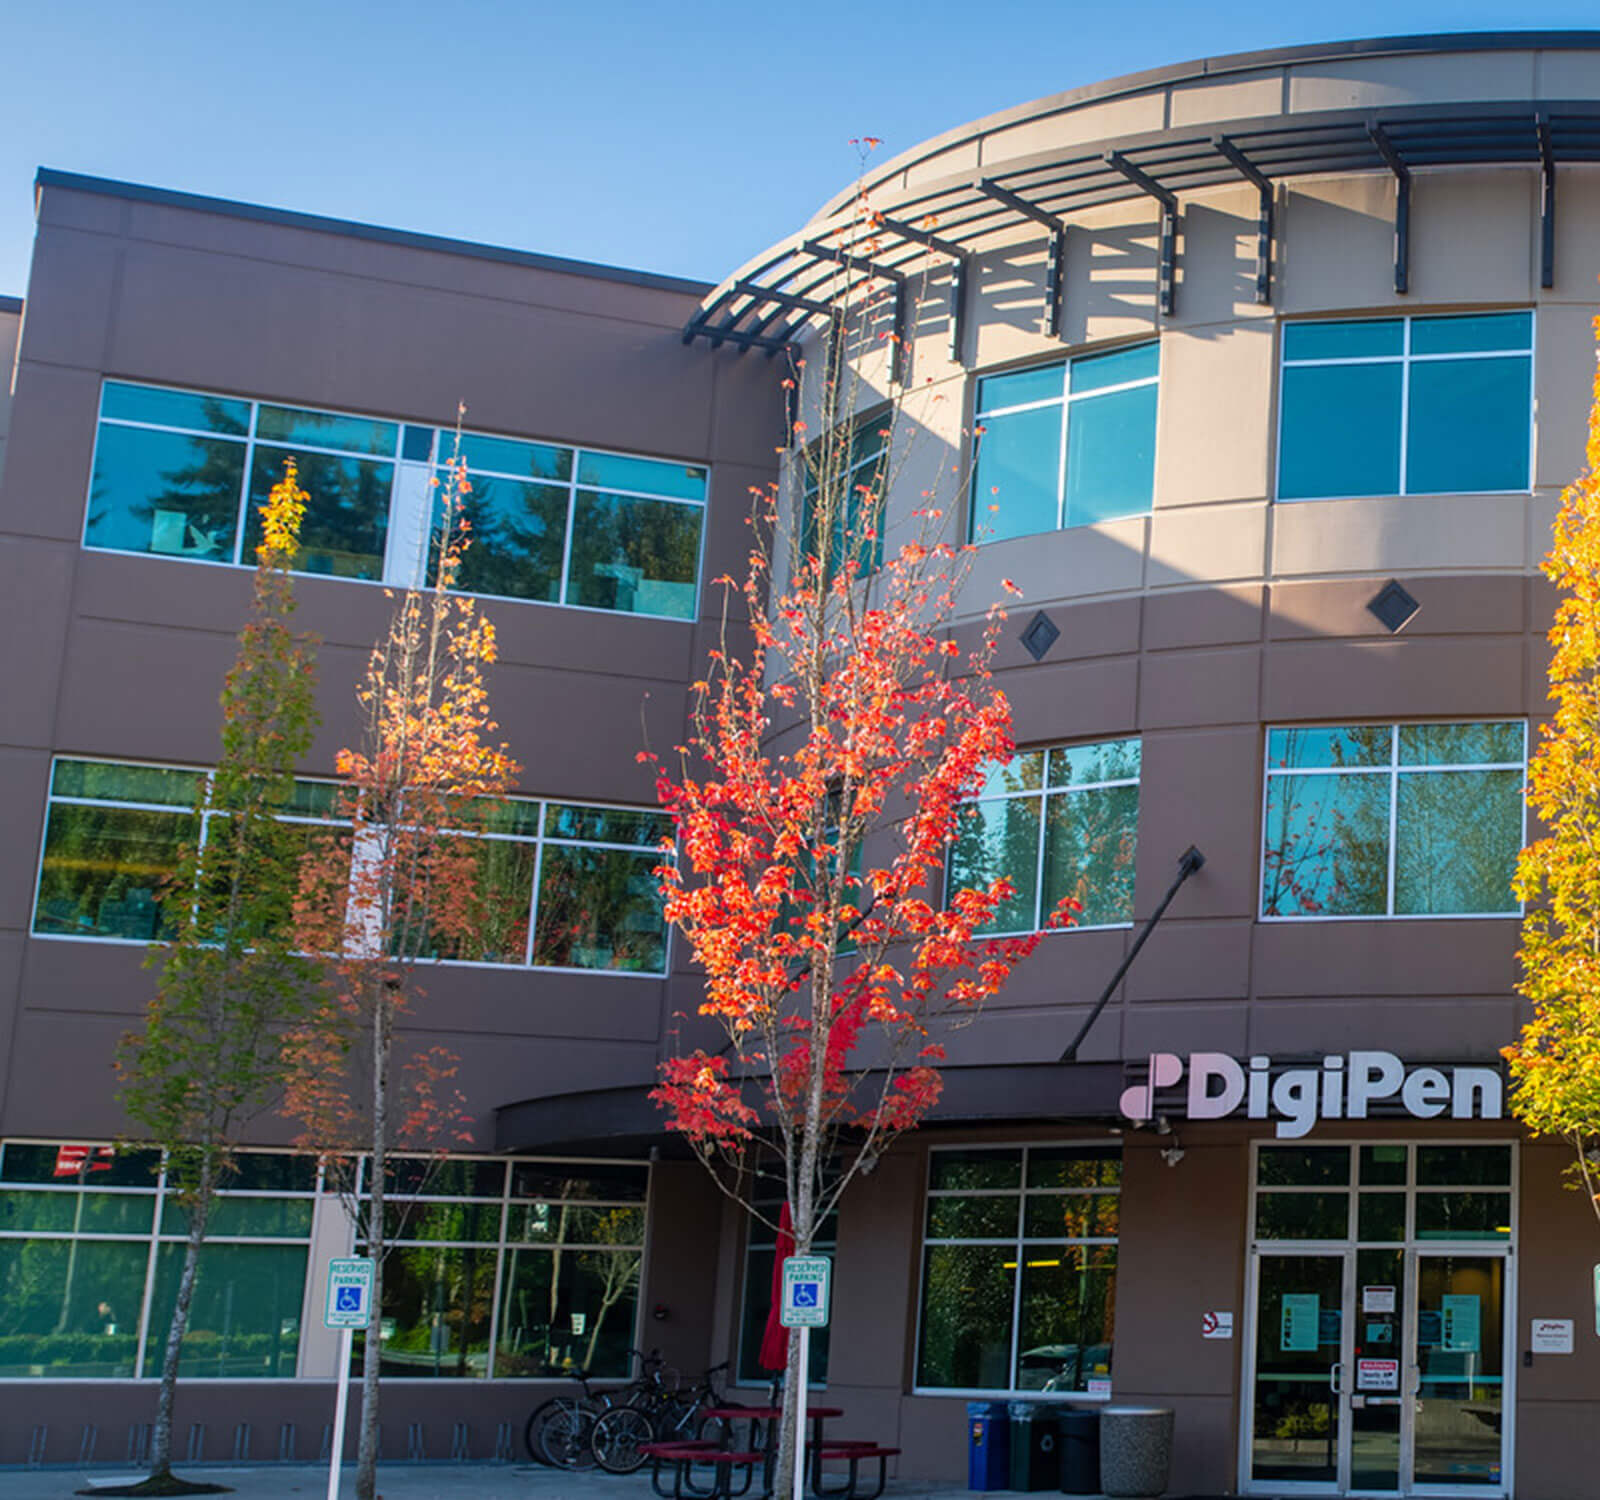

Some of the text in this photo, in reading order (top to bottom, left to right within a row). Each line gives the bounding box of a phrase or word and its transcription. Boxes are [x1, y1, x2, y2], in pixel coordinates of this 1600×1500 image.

[1187, 1050, 1503, 1138] DigiPen
[334, 1275, 367, 1286] PARKING
[788, 1273, 824, 1283] PARKING
